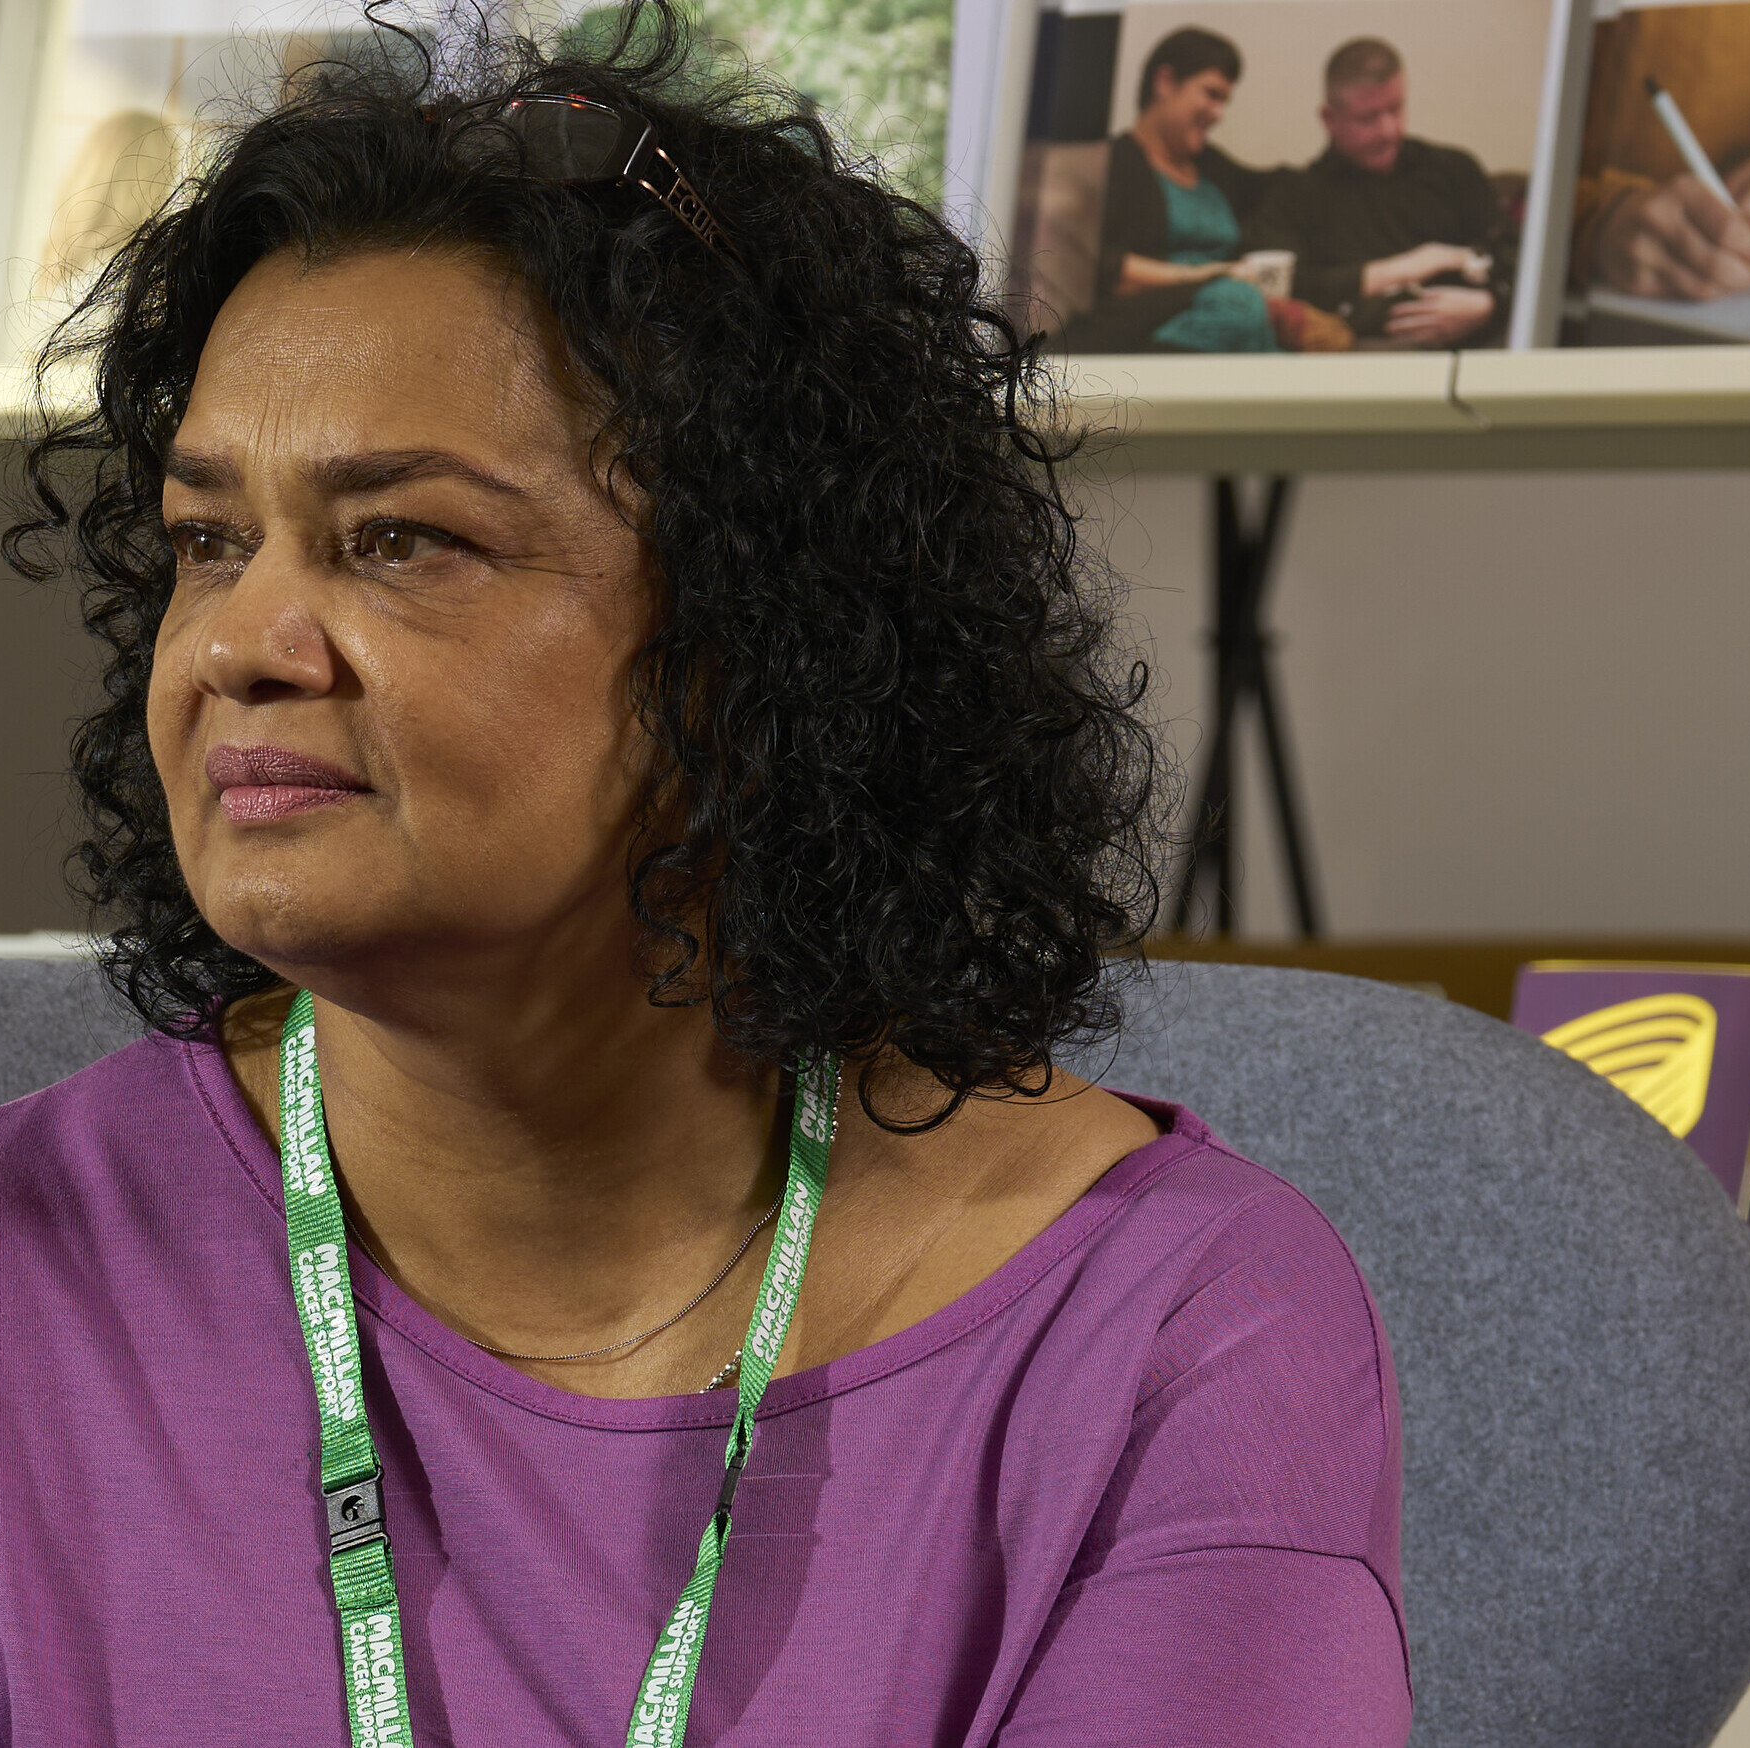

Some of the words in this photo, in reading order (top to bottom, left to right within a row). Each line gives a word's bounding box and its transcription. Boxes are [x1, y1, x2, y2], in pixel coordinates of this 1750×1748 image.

[285, 1037, 297, 1108] CANCER
[285, 1108, 304, 1191] SUPPORT
[297, 1026, 327, 1196] MACMILLAN
[298, 1251, 324, 1328] CANCER
[312, 1330, 340, 1417] SUPPORT
[315, 1243, 358, 1421] MACMILLAN
[752, 1181, 808, 1358] MACMILLAN
[765, 1290, 794, 1364] CANCER
[789, 1203, 814, 1289] SUPPORT
[349, 1622, 370, 1692] CANCER
[669, 1606, 704, 1689] SUPPORT
